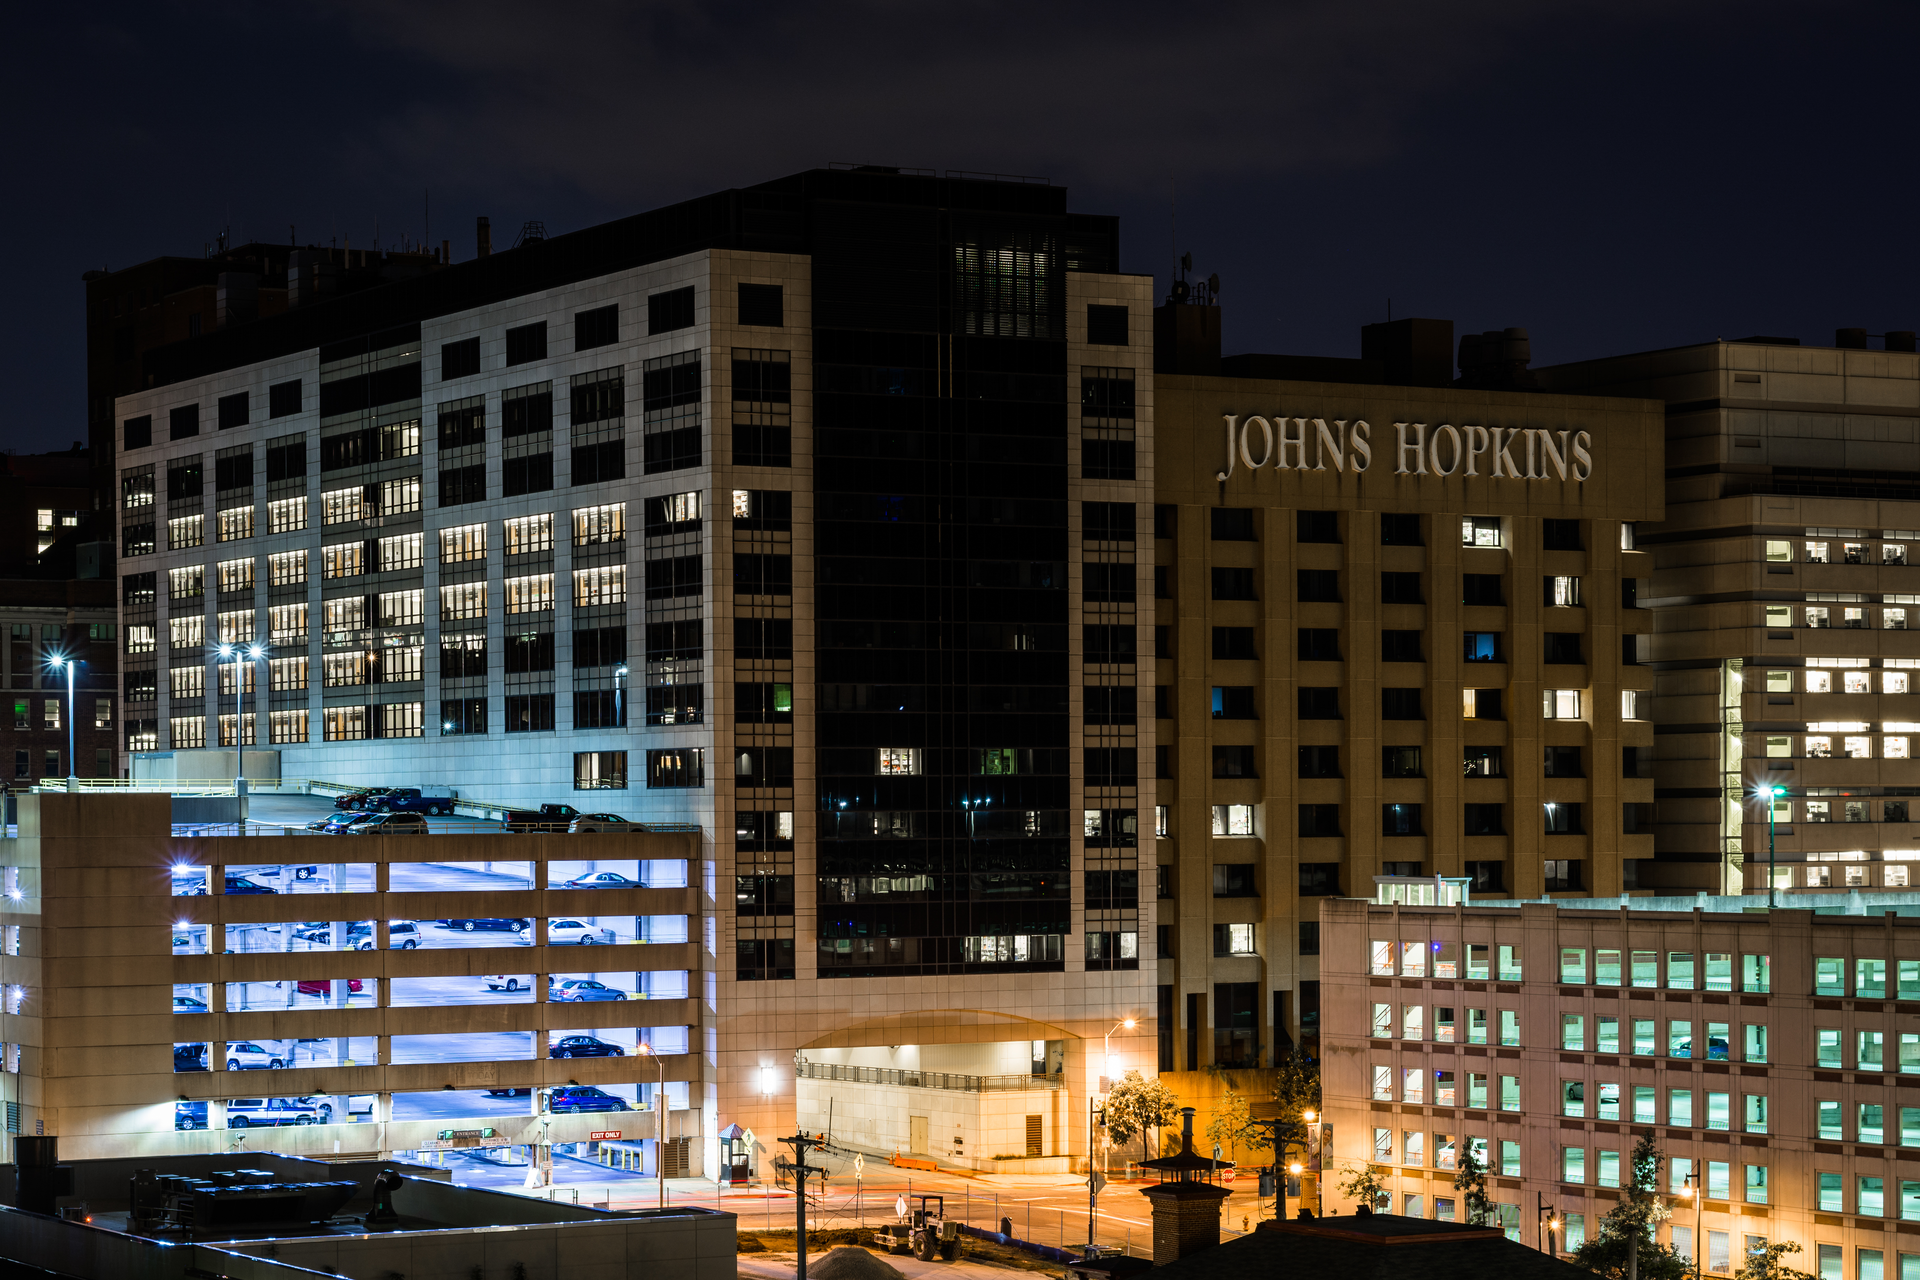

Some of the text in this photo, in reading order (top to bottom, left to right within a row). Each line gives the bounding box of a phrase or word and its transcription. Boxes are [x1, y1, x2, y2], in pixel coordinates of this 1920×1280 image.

[1216, 414, 1593, 481] JOHNS HOPKINS
[543, 1095, 548, 1109] P
